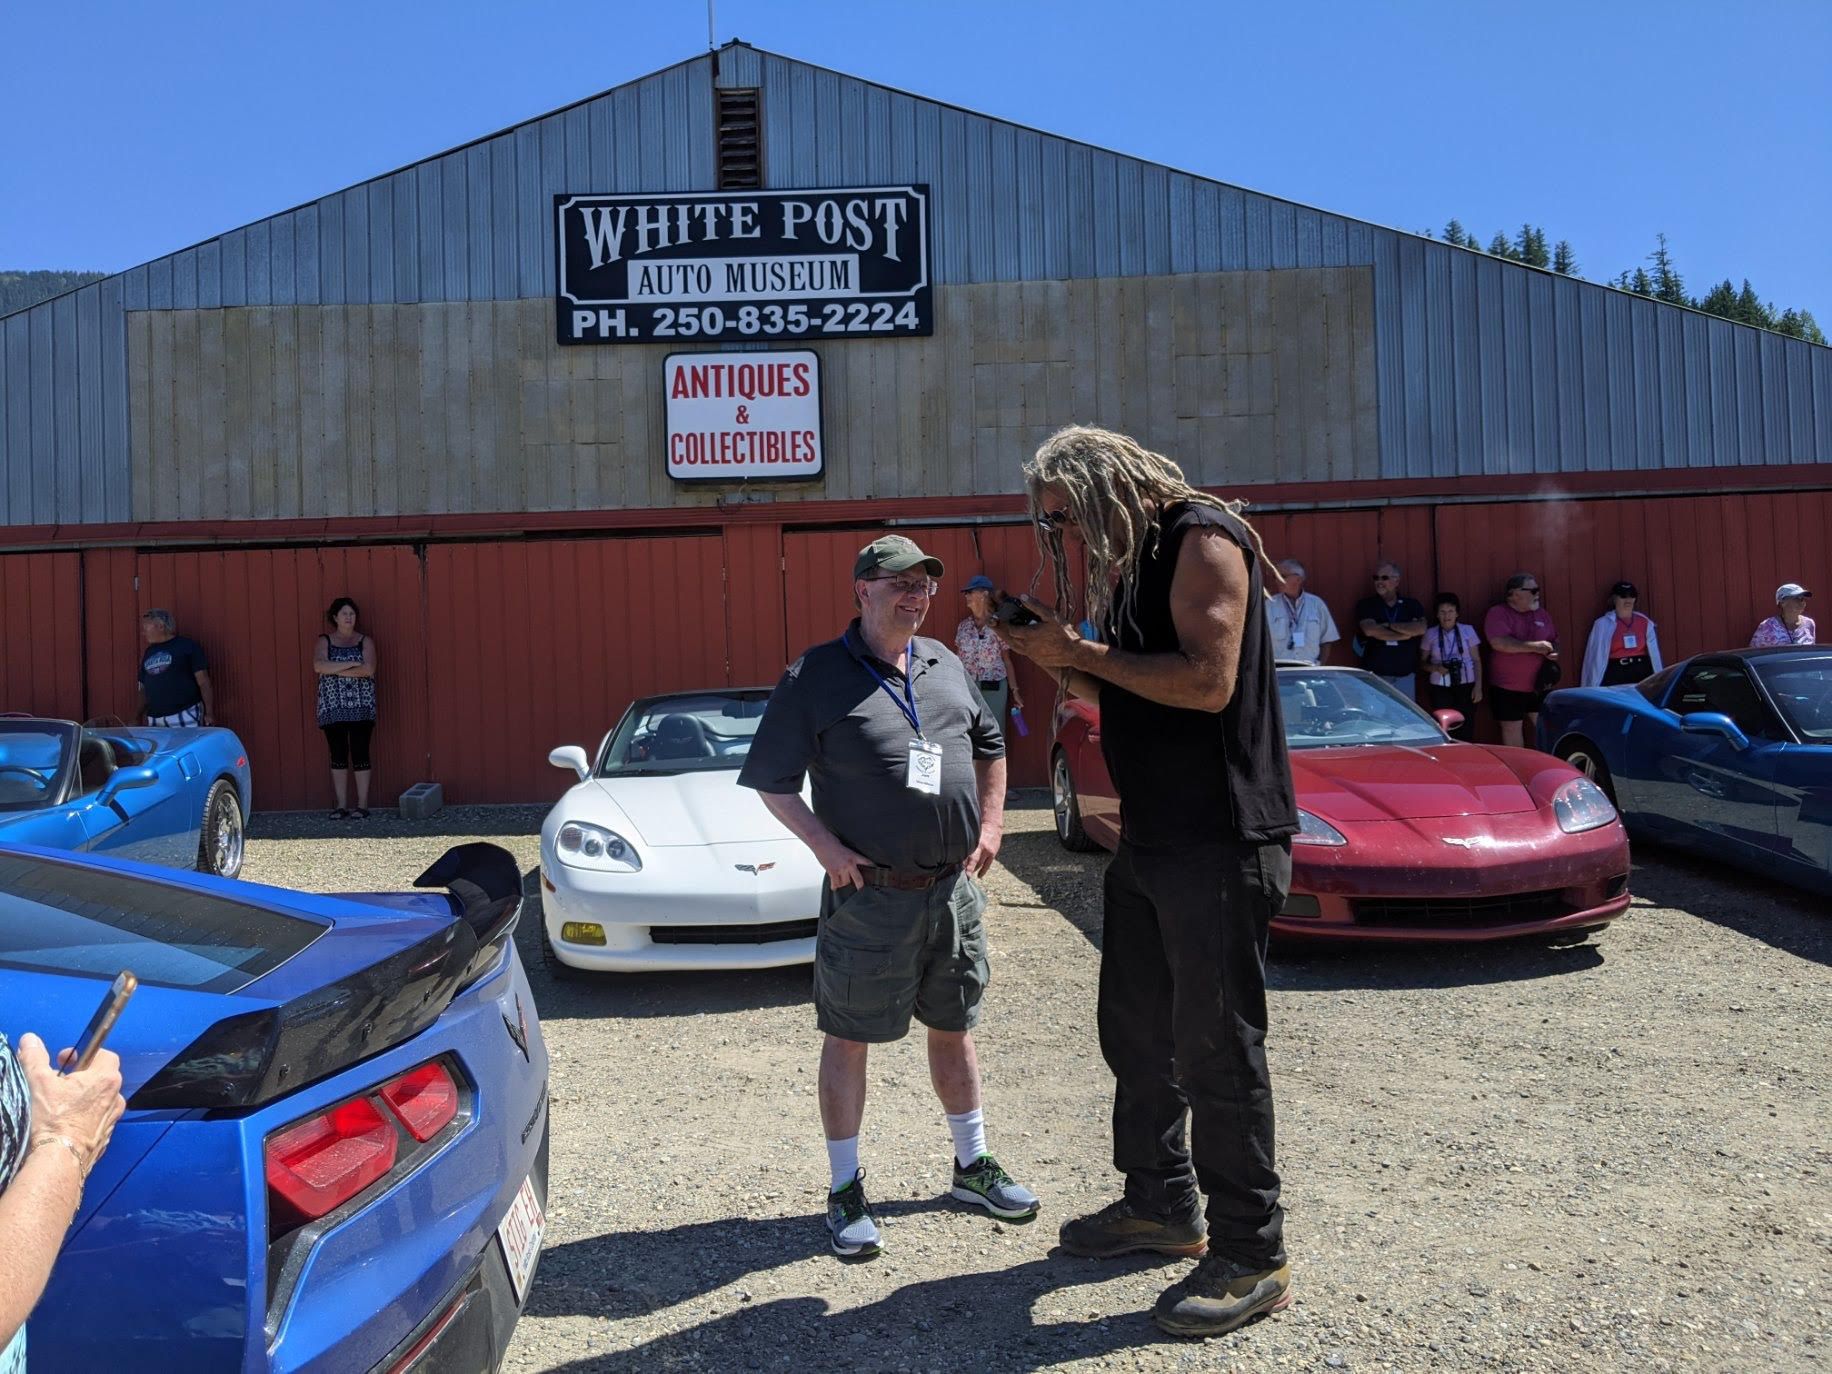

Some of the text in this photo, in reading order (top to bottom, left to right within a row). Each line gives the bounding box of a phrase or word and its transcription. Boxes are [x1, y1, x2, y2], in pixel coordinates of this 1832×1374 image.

[578, 198, 907, 271] WHITE POST
[638, 259, 851, 296] AUTO MUSEUM
[572, 301, 919, 337] PH. 250-835-2224
[671, 363, 810, 400] ANTIQUES
[735, 405, 750, 424] &
[670, 430, 816, 465] COLLECTIBLES
